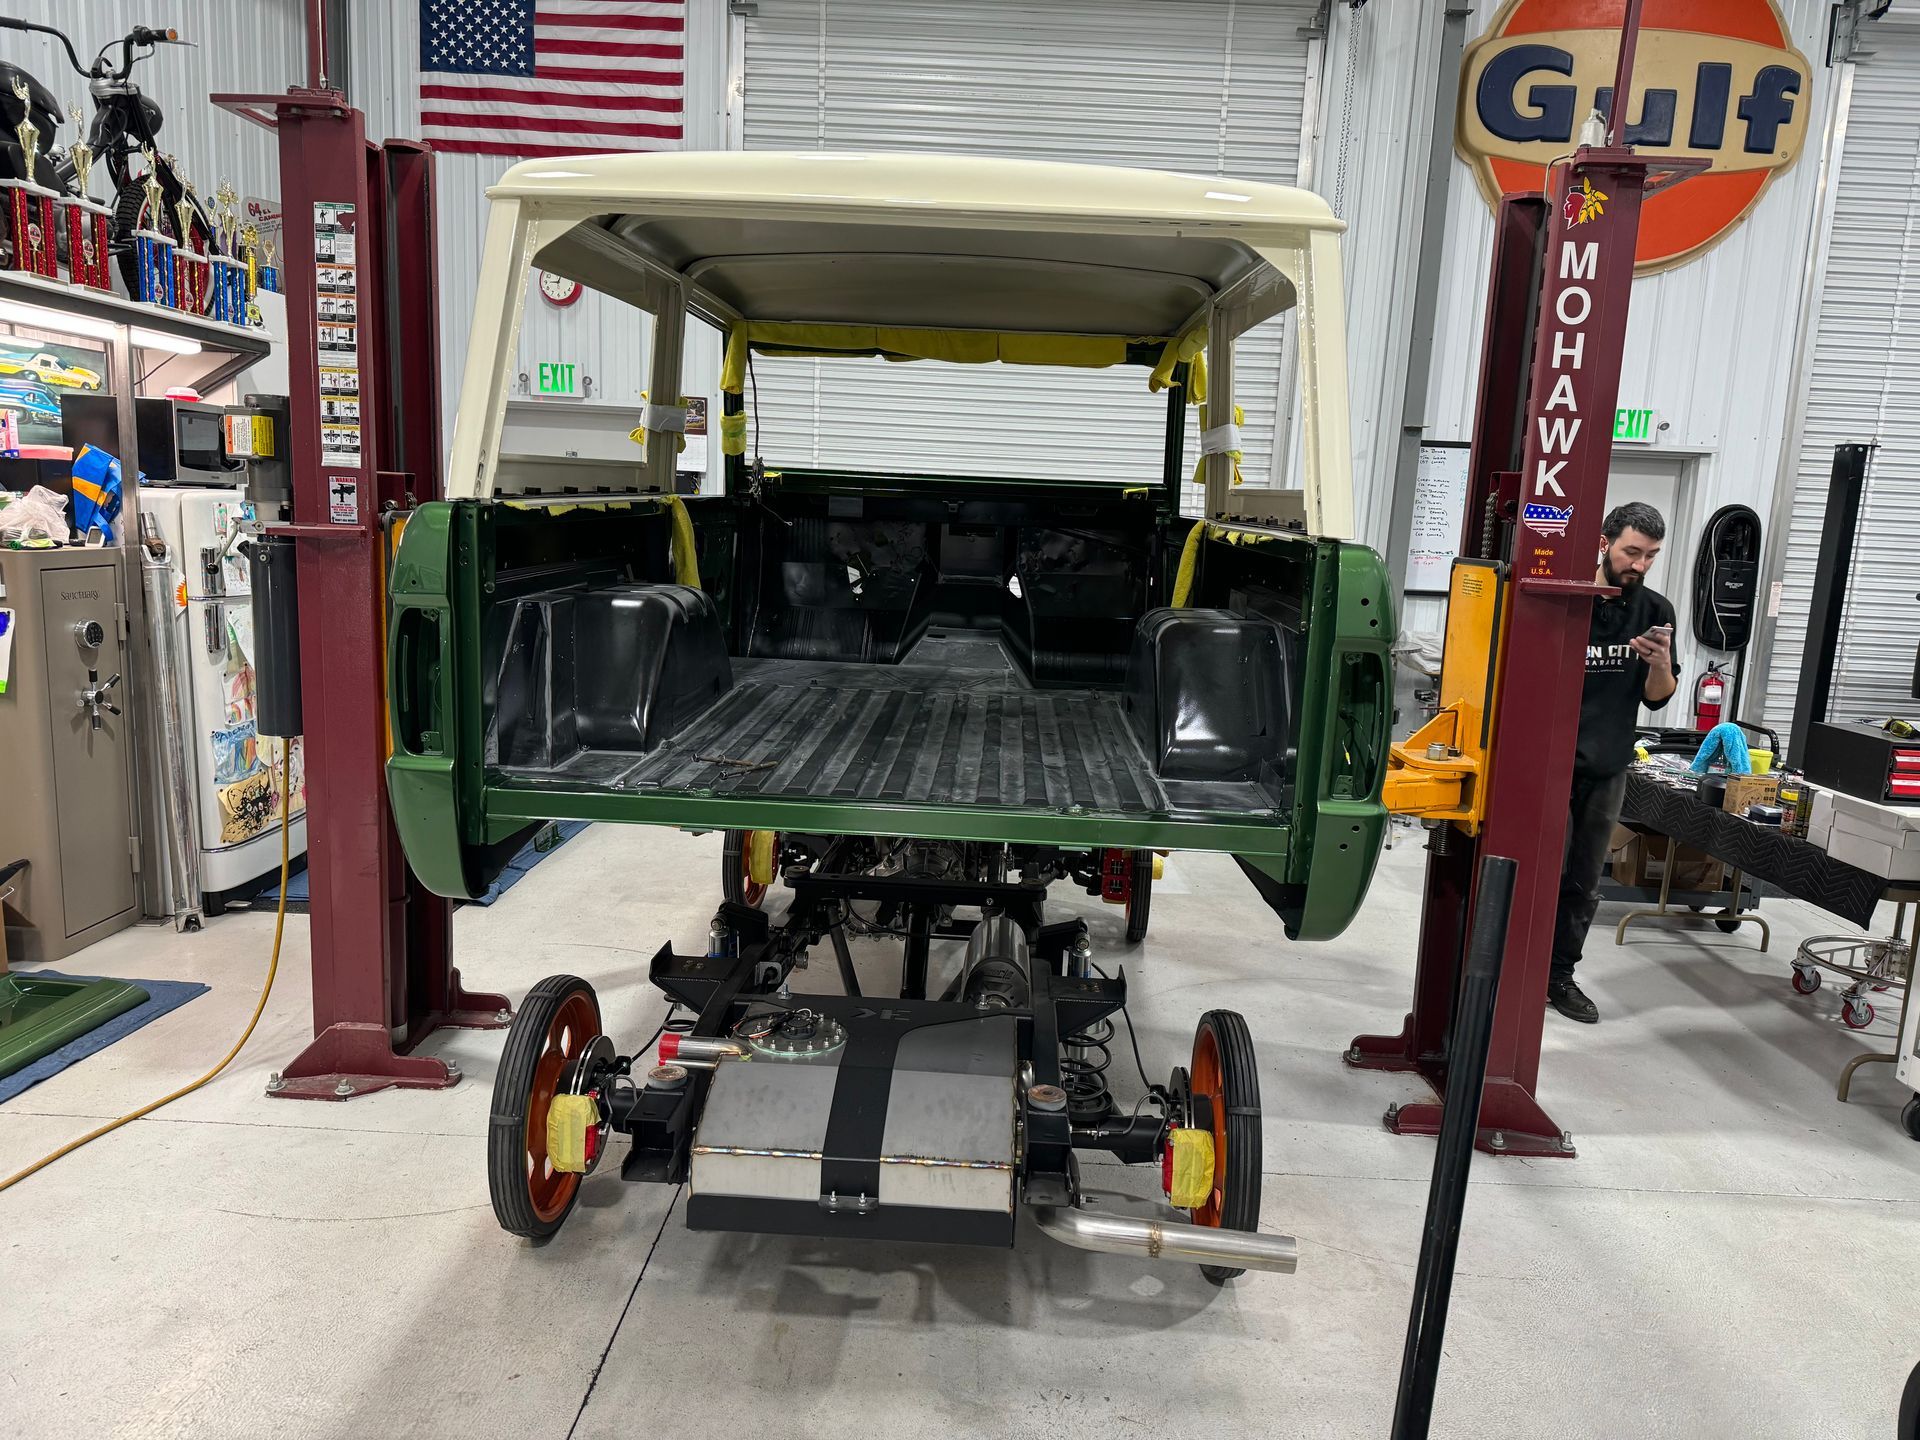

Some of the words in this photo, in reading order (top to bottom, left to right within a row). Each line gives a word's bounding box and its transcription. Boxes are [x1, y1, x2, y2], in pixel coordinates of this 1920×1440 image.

[1476, 44, 1802, 154] Gulf
[539, 362, 575, 393] EXIT
[1534, 241, 1599, 498] MOHAWK
[1613, 409, 1653, 438] EXIT
